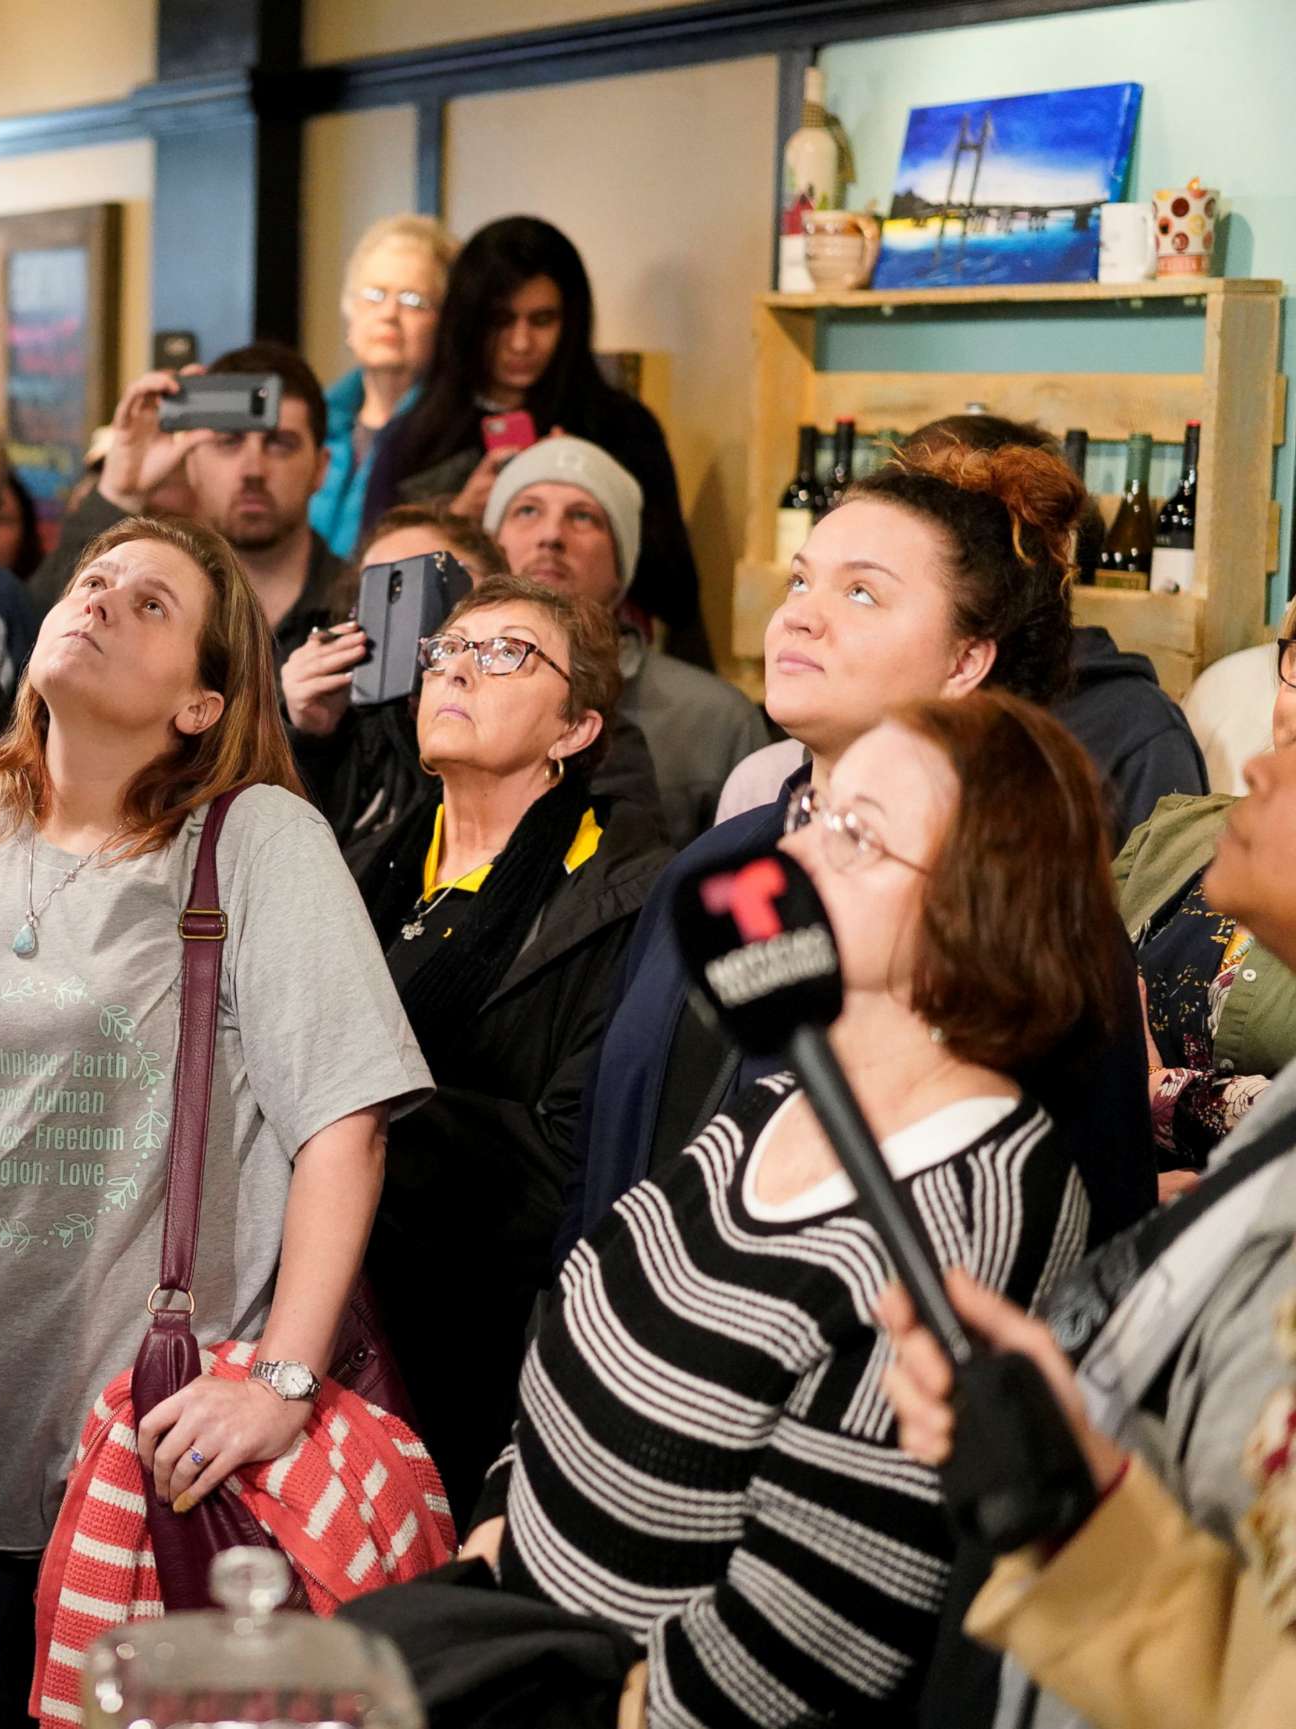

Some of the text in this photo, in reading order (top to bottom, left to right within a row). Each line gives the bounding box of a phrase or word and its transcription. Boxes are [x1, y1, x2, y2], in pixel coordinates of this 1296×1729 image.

[72, 1051, 127, 1079] Earth
[33, 1087, 105, 1114] Human
[35, 1123, 125, 1151] Freedom
[59, 1160, 105, 1187] Love
